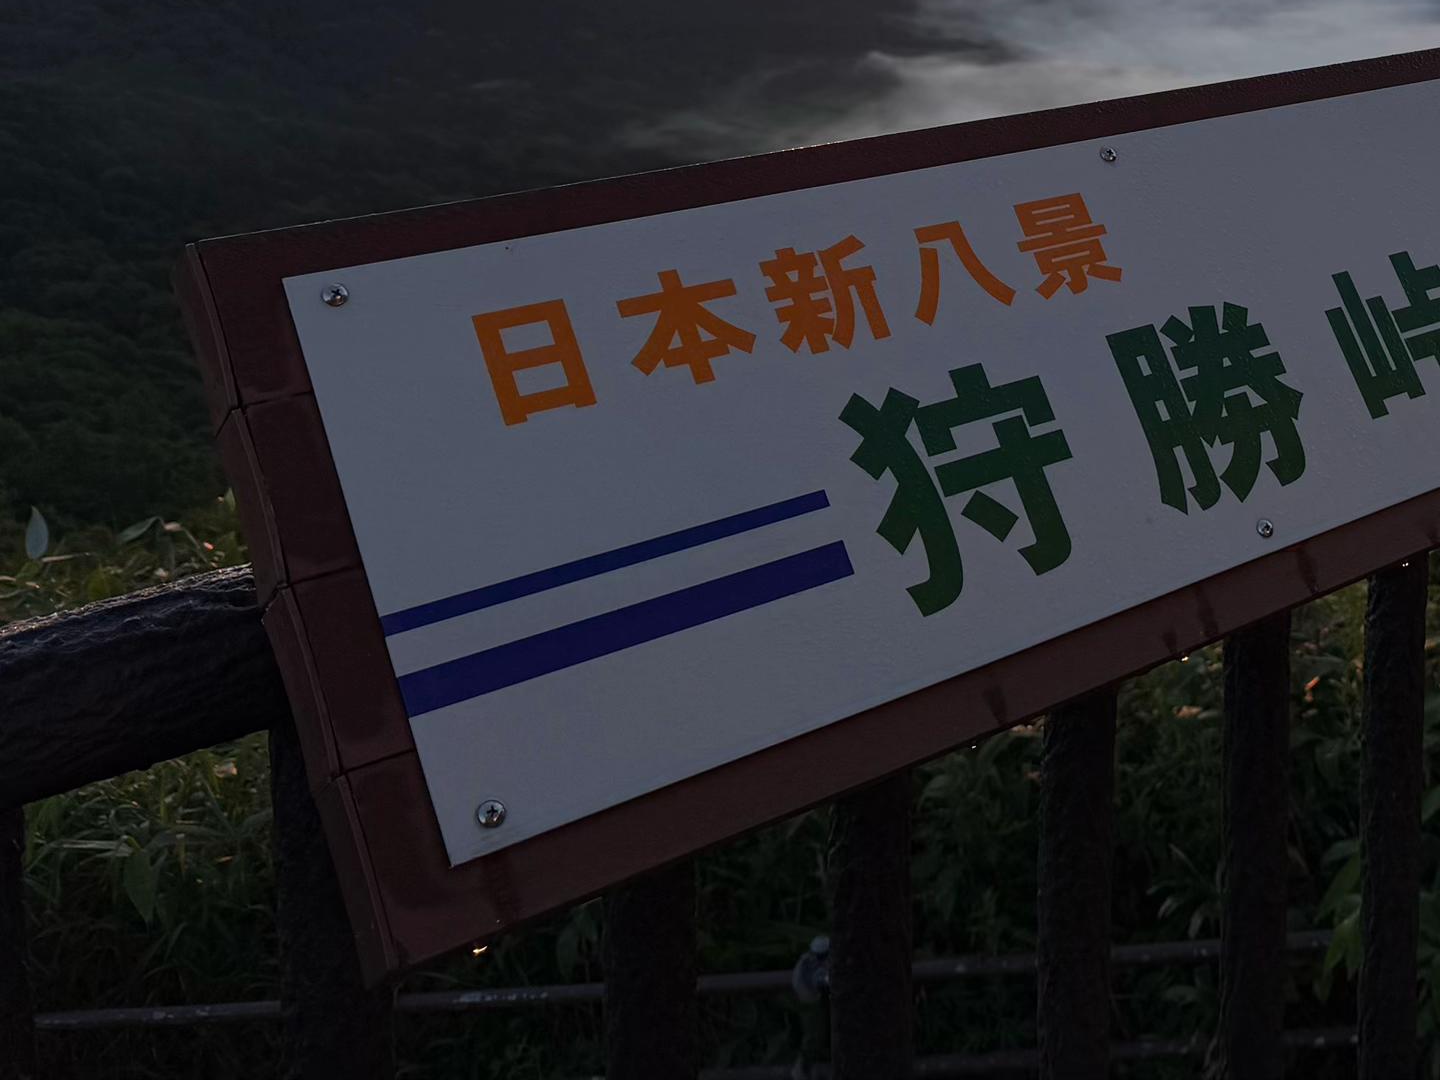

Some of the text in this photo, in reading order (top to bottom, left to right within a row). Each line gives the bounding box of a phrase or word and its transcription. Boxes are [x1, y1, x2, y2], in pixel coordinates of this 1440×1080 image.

[472, 192, 1122, 426] 日本新八景
